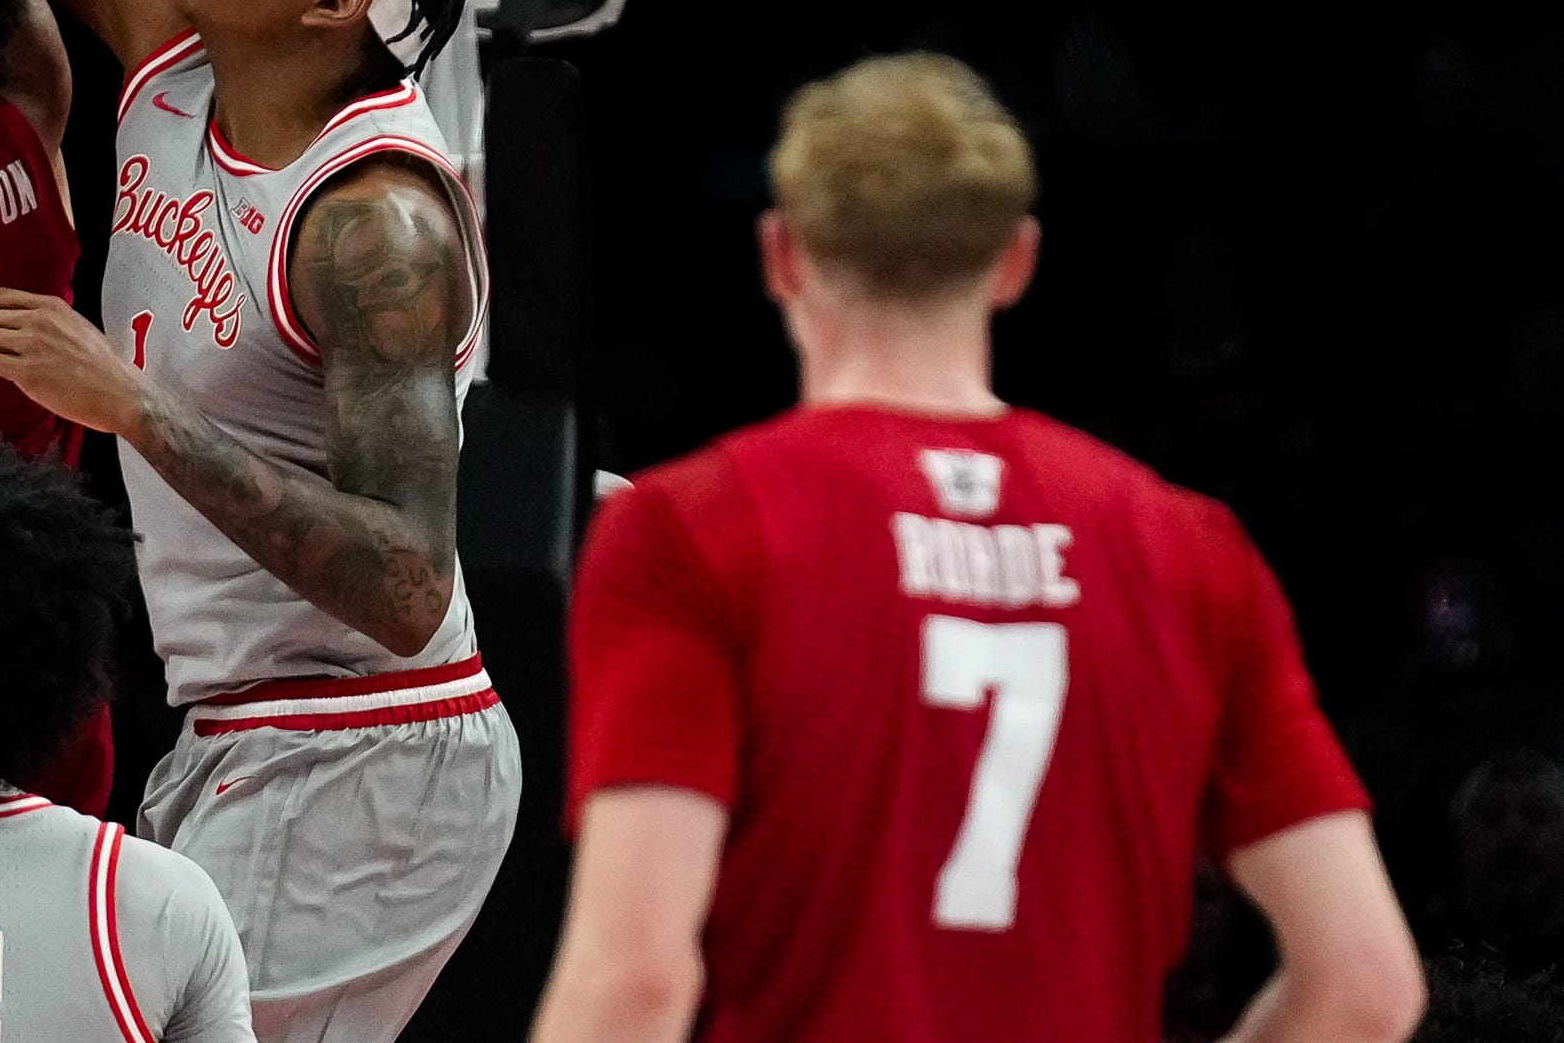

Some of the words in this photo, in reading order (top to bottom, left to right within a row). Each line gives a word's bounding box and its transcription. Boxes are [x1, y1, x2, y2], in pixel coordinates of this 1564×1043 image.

[110, 154, 248, 349] Buckeyes
[131, 309, 154, 371] 1
[920, 613, 1069, 932] 7
